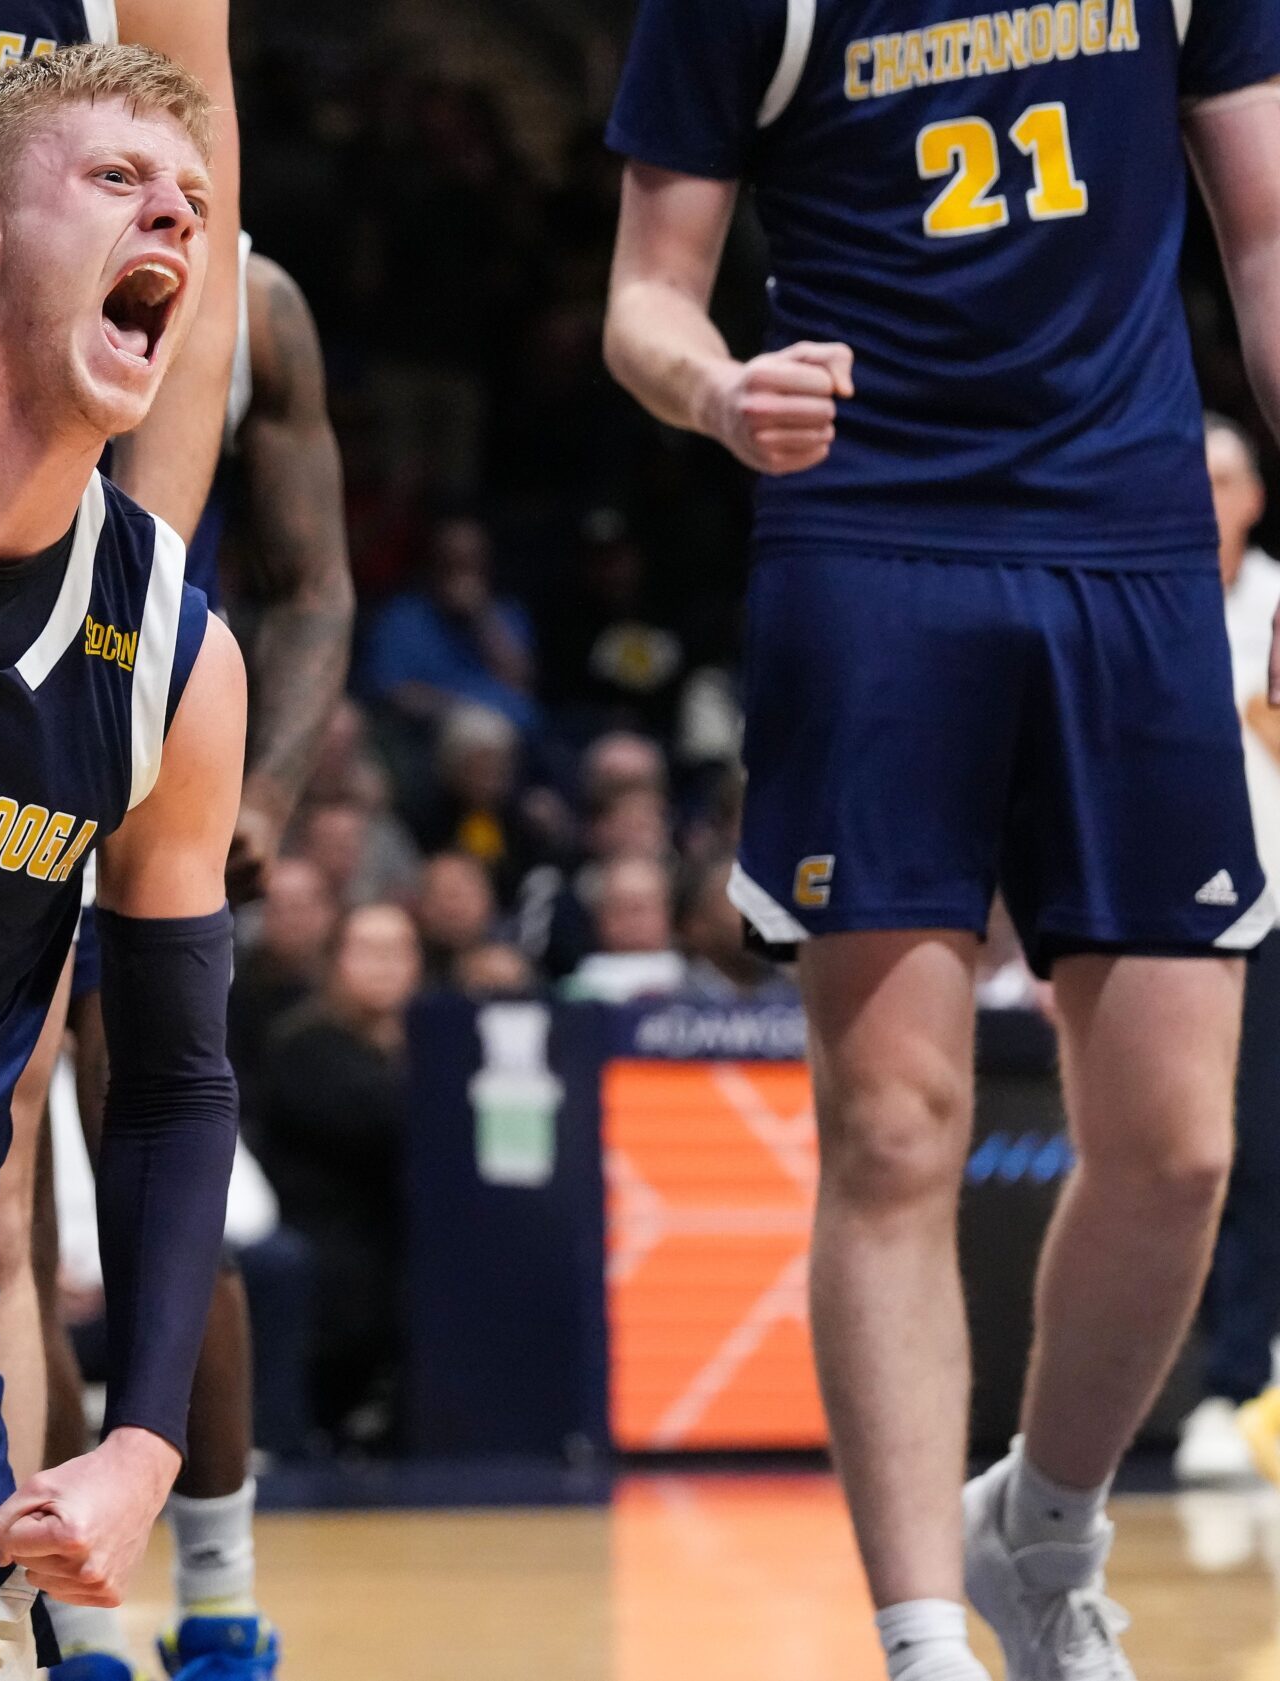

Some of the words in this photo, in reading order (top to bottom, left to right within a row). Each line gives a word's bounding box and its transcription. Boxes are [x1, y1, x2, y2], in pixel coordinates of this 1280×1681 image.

[844, 0, 1140, 100] CHATTANOOGA
[915, 101, 1089, 238] 21
[792, 854, 836, 910] C
